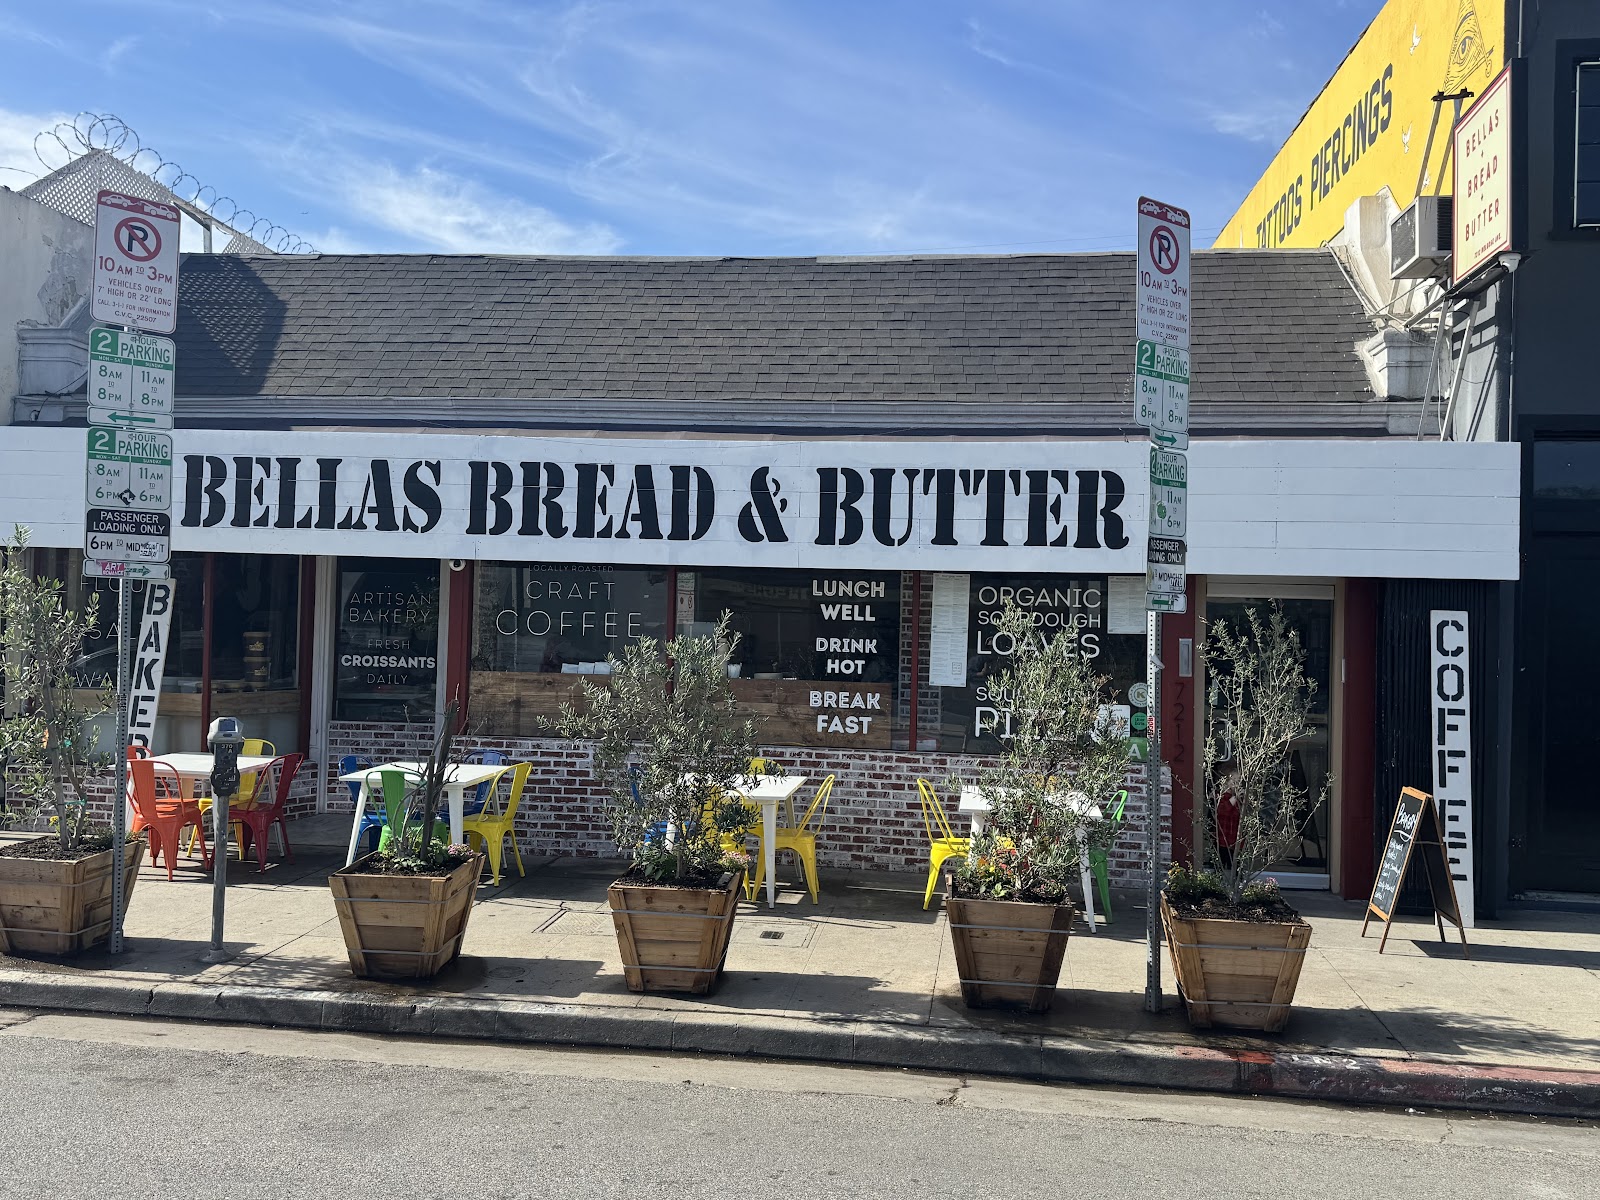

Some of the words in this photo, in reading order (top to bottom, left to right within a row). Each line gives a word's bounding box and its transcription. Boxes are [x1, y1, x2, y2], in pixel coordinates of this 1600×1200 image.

[1311, 62, 1393, 211] PIERCINGS
[1465, 109, 1500, 158] BELLAS
[1467, 155, 1498, 198] BREAD
[1256, 174, 1303, 248] TATTOOS
[1465, 198, 1500, 242] BUTTER
[135, 265, 145, 275] TO
[108, 277, 142, 292] VEHICLES
[144, 285, 163, 296] OVER
[107, 287, 125, 298] HIGH
[127, 291, 137, 300] OR
[154, 296, 172, 307] LONG
[1146, 294, 1169, 308] VEHICLES
[1169, 300, 1182, 311] OVER
[136, 315, 157, 324] 22507
[97, 332, 113, 353] 2
[134, 336, 158, 348] HOUR
[120, 342, 171, 364] PARKING
[1141, 343, 1152, 366] 2
[1155, 354, 1188, 377] PARKING
[94, 430, 110, 452] 2
[132, 434, 157, 444] HOUR
[118, 440, 169, 459] PARKING
[1161, 453, 1178, 464] HOUR
[181, 454, 442, 533] BELLAS
[466, 460, 715, 542] BREAD
[738, 466, 789, 543] &
[814, 467, 1129, 550] BUTTER
[100, 511, 159, 524] PASSENGER
[93, 521, 137, 533] LOADING
[140, 524, 166, 536] ONLY
[116, 538, 125, 548] TO
[1167, 552, 1183, 563] ONLY
[528, 564, 571, 573] LOCALLY
[571, 565, 615, 574] ROASTED
[525, 580, 616, 601] CRAFT
[811, 579, 886, 598] LUNCH
[978, 586, 1102, 608] ORGANIC
[349, 592, 433, 606] ARTISAN
[349, 608, 432, 624] BAKERY
[820, 603, 876, 622] WELL
[495, 609, 643, 639] COFFEE
[367, 639, 411, 651] FRESH
[815, 637, 878, 654] DRINK
[340, 654, 437, 669] CROISSANTS
[826, 659, 866, 675] HOT
[366, 673, 409, 686] DAILY
[809, 691, 881, 710] BREAK
[816, 715, 873, 734] FAST
[1173, 682, 1186, 764] 7212
[1127, 743, 1142, 760] A
